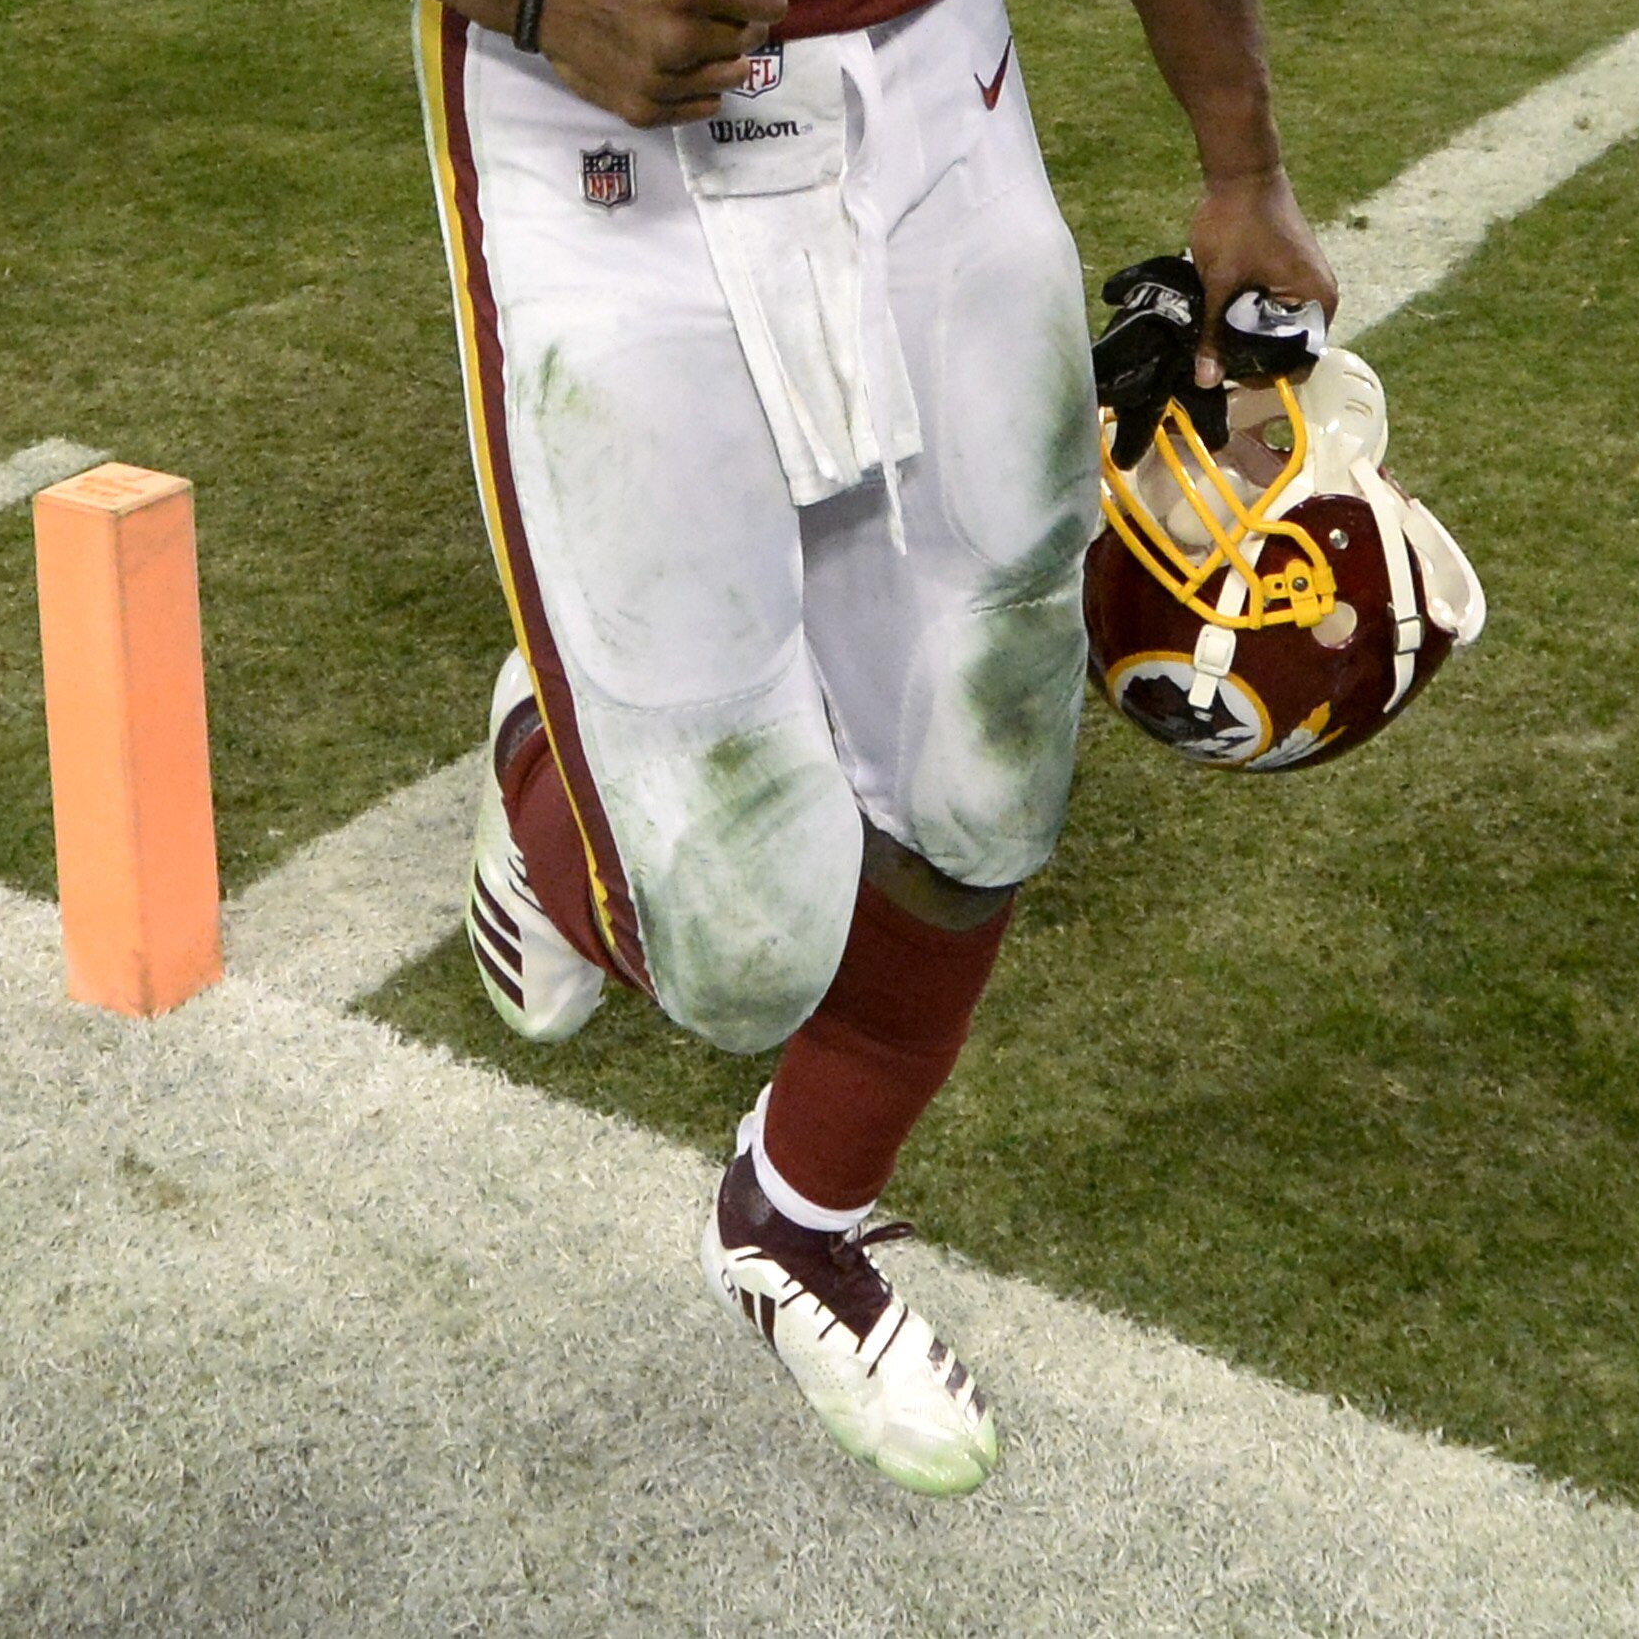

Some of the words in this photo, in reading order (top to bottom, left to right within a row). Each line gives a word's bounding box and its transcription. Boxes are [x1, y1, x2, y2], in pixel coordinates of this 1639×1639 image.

[742, 59, 777, 91] FL
[708, 119, 799, 144] Wilson
[588, 174, 626, 201] NFL
